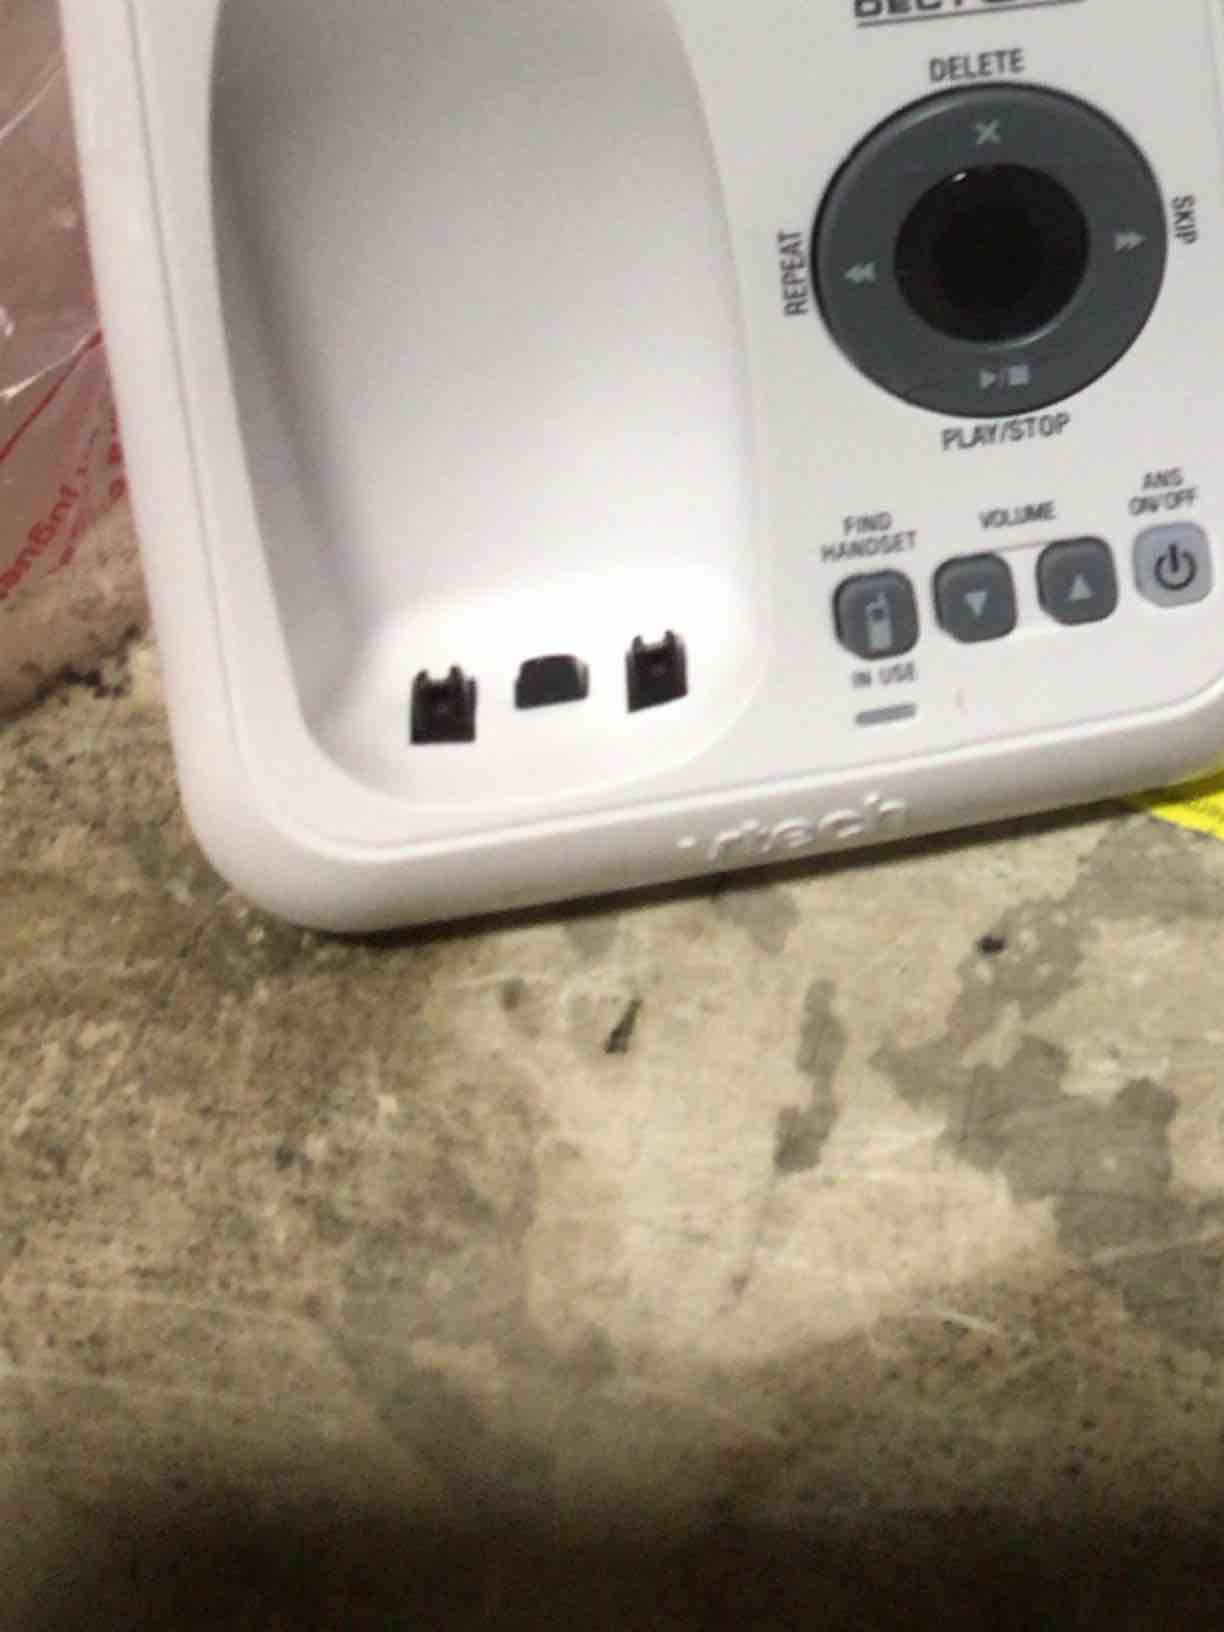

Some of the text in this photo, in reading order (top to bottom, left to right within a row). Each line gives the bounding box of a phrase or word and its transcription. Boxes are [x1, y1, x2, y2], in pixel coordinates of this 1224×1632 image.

[929, 46, 1026, 83] DELETE
[1169, 192, 1199, 246] SKIP
[777, 228, 811, 318] REPEAT
[941, 411, 1073, 452] PLAY/STOP
[1142, 467, 1185, 492] ANS
[978, 500, 1058, 530] VOLUME
[1129, 487, 1200, 516] ON/OFF
[843, 511, 894, 538] FIND
[820, 530, 919, 564] HANDSET
[850, 661, 917, 690] IN USE
